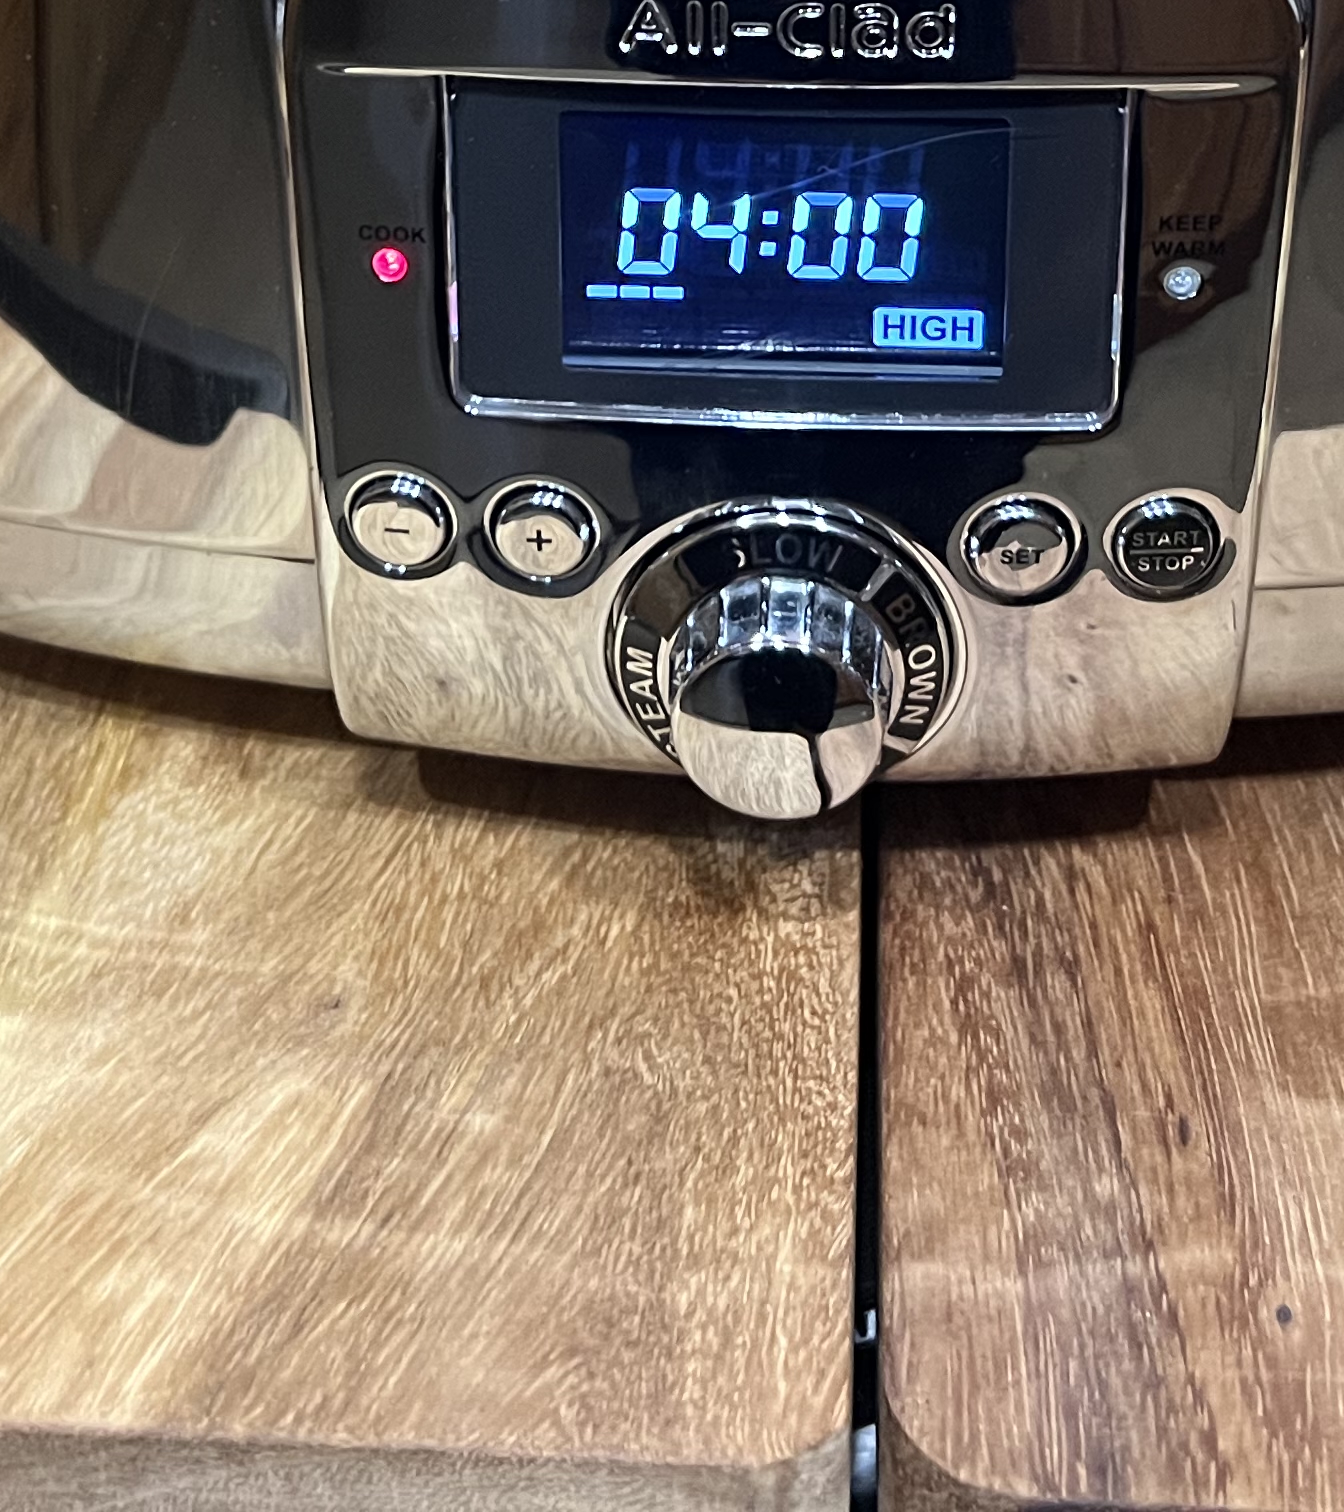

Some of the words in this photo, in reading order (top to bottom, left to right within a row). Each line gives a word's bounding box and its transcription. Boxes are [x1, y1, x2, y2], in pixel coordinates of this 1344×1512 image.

[1158, 214, 1223, 232] KEEP
[358, 224, 426, 244] COOK
[616, 188, 925, 281] 04:00
[1151, 240, 1226, 258] WARM
[882, 313, 976, 343] HIGH
[1131, 529, 1201, 547] START
[999, 547, 1045, 565] SET
[1136, 555, 1196, 573] STOP
[884, 592, 938, 725] BROWN
